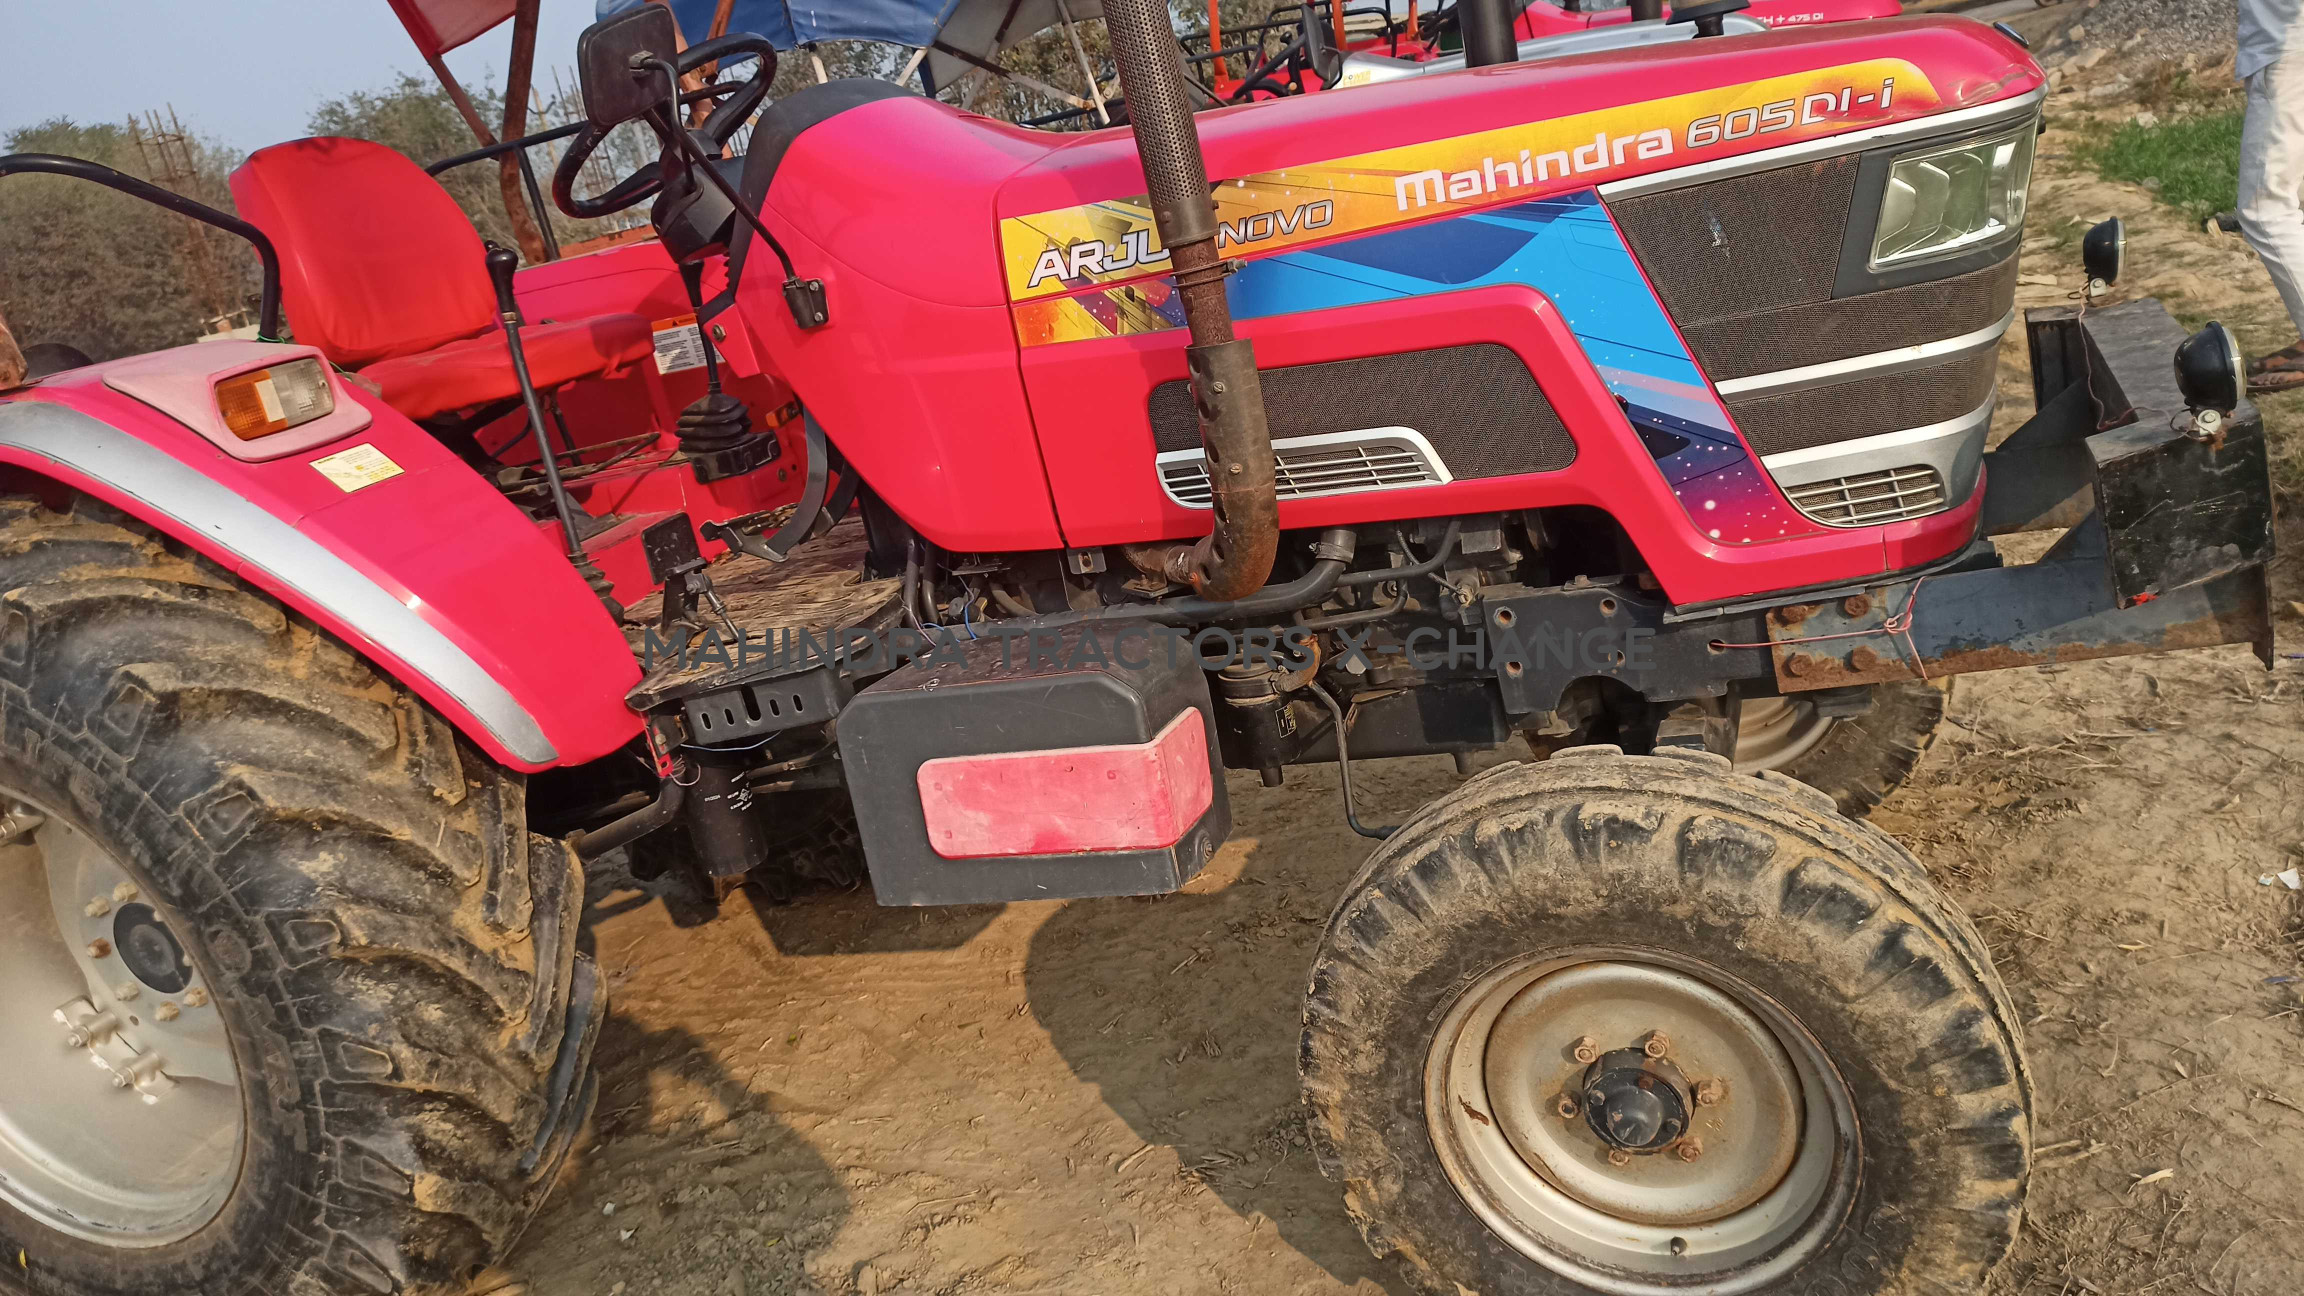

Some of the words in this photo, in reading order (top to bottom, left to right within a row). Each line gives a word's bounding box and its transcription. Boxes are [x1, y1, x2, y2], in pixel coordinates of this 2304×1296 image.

[1788, 13, 1810, 23] 475
[1812, 12, 1824, 20] DI
[1394, 127, 1674, 211] Mahindra
[1217, 200, 1334, 248] NOVO
